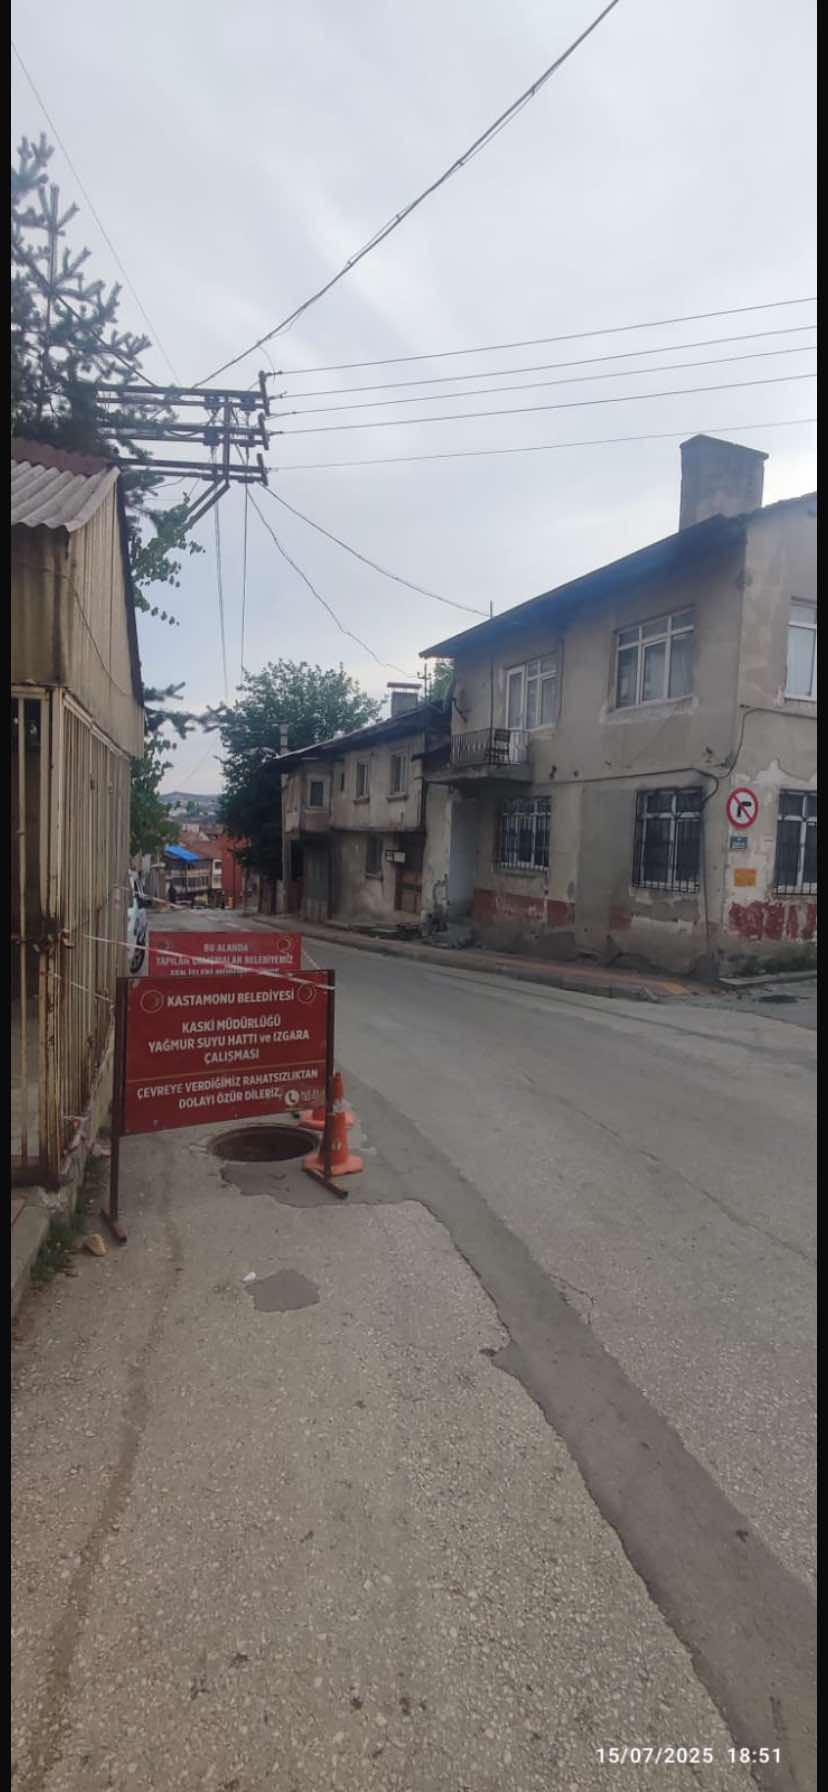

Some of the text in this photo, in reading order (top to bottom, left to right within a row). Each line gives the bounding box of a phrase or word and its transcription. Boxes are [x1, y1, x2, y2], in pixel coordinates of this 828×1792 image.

[167, 987, 295, 1007] KASTAMONU BELEDİYESİ
[182, 1014, 281, 1033] KASKİ MÜDÜRLÜĞÜ
[149, 1029, 310, 1053] YAĞMUR SUYU HATTI ve IZGARA
[137, 1069, 317, 1099] ÇEVREYE VERDİĞİMİZ RAHATSIZLIKTAN
[179, 1095, 215, 1109] DOLAYI
[216, 1090, 243, 1105] ÖZÜR
